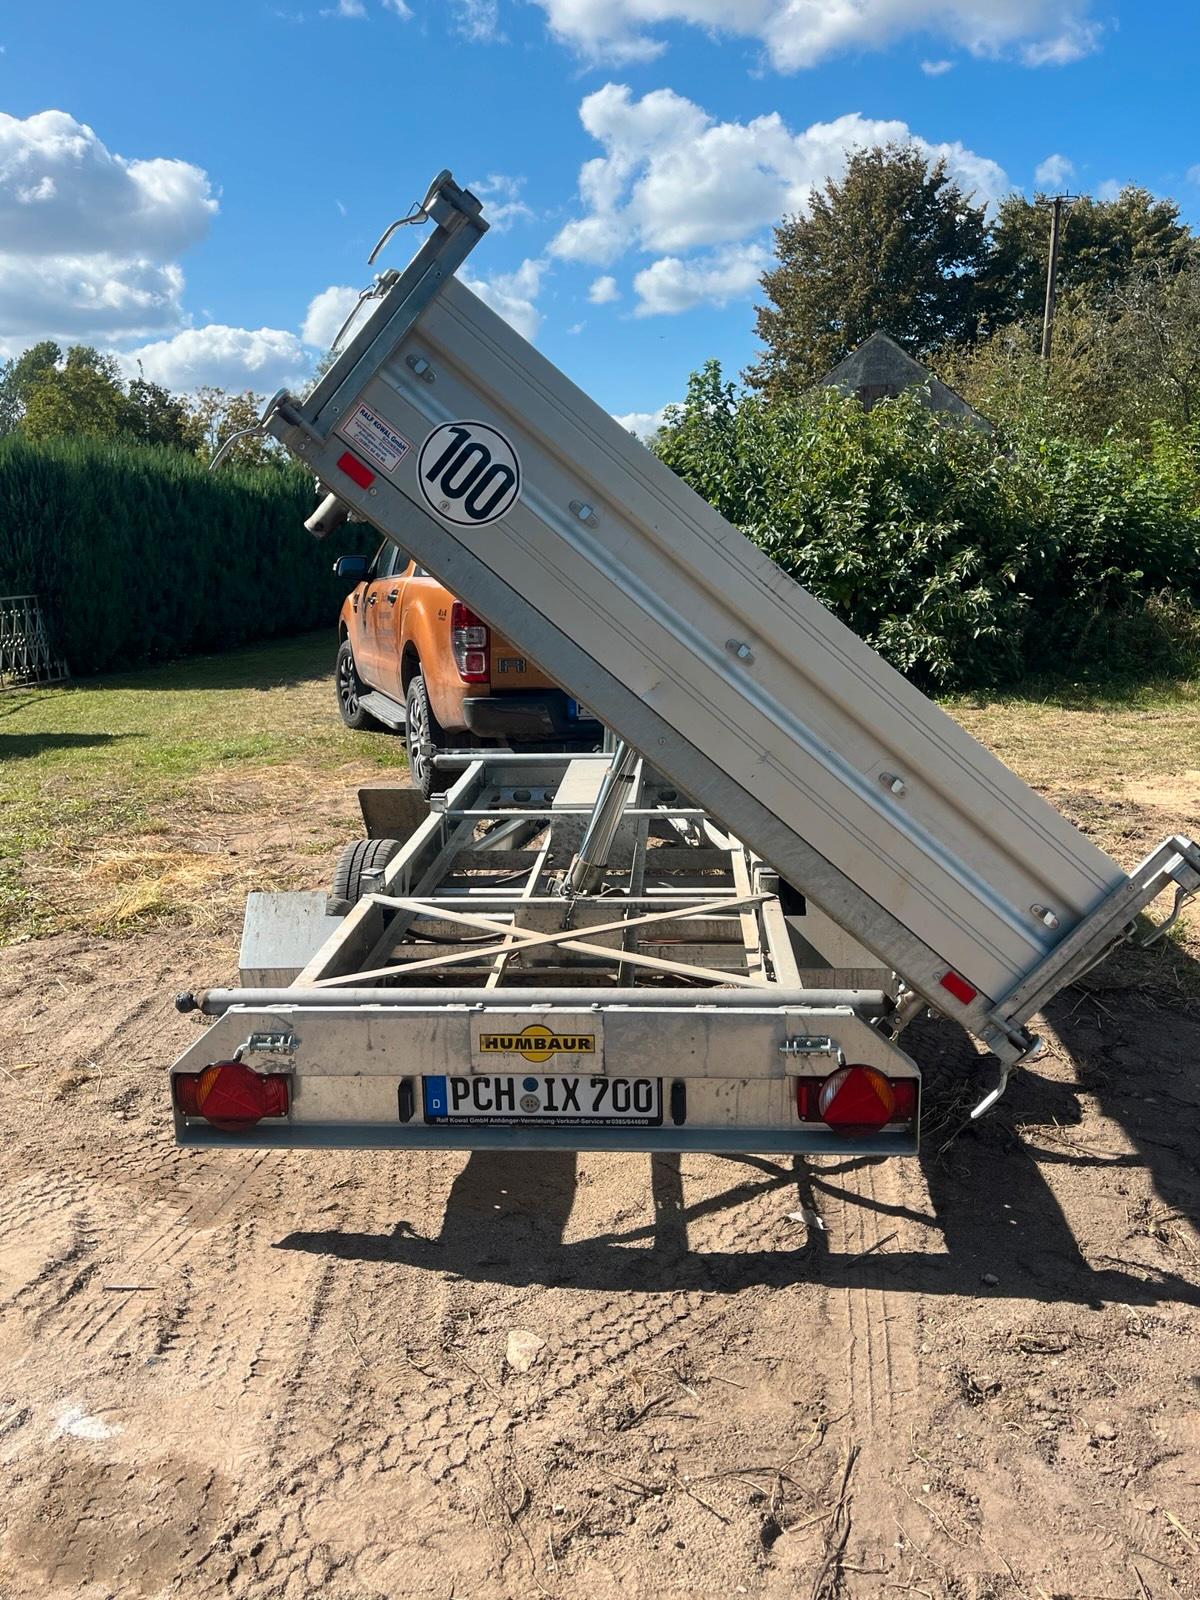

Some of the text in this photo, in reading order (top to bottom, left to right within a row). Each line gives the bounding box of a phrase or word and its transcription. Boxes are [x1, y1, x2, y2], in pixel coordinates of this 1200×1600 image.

[360, 408, 375, 422] RALF
[373, 420, 391, 439] KOWAL
[390, 435, 407, 451] GmbH
[425, 426, 515, 520] 100
[485, 1037, 592, 1050] HUMBAUR
[432, 1098, 441, 1109] D
[450, 1077, 653, 1113] PCH IX 700
